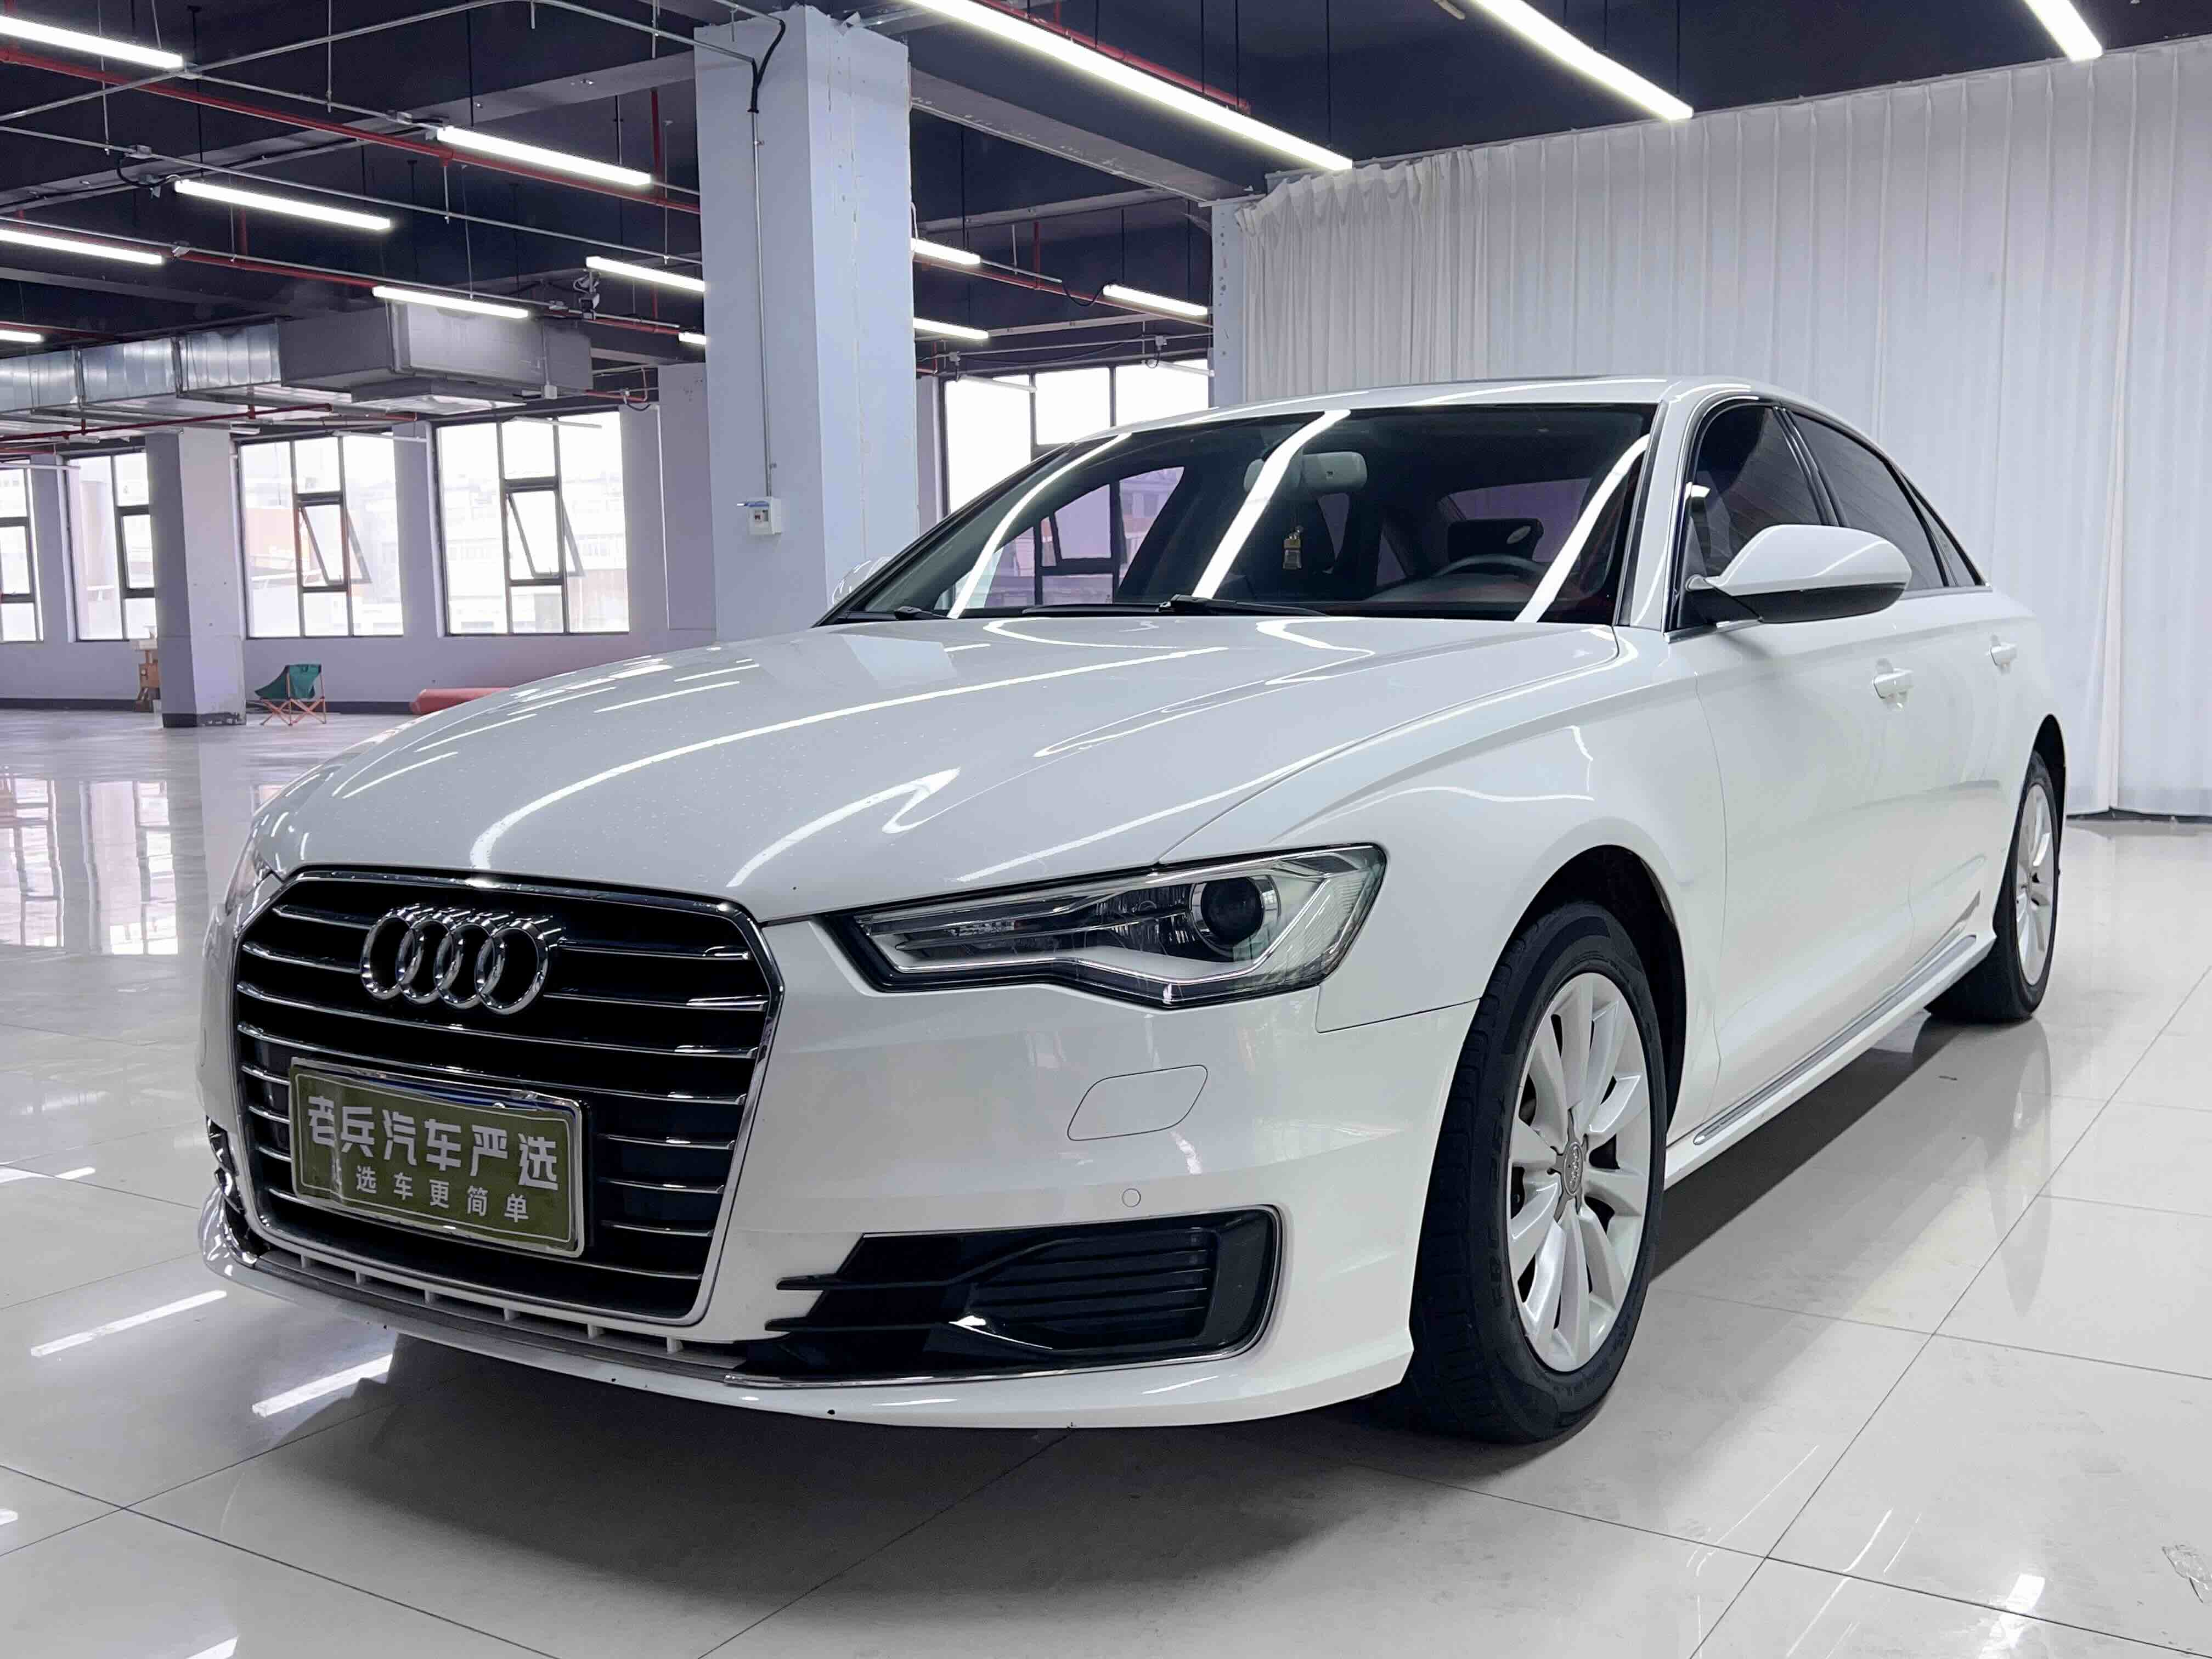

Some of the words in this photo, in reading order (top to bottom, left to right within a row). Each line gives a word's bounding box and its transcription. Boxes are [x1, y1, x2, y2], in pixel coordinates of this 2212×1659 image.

[308, 1096, 558, 1191] 老兵汽车严选
[356, 1165, 529, 1223] 选车更简单
